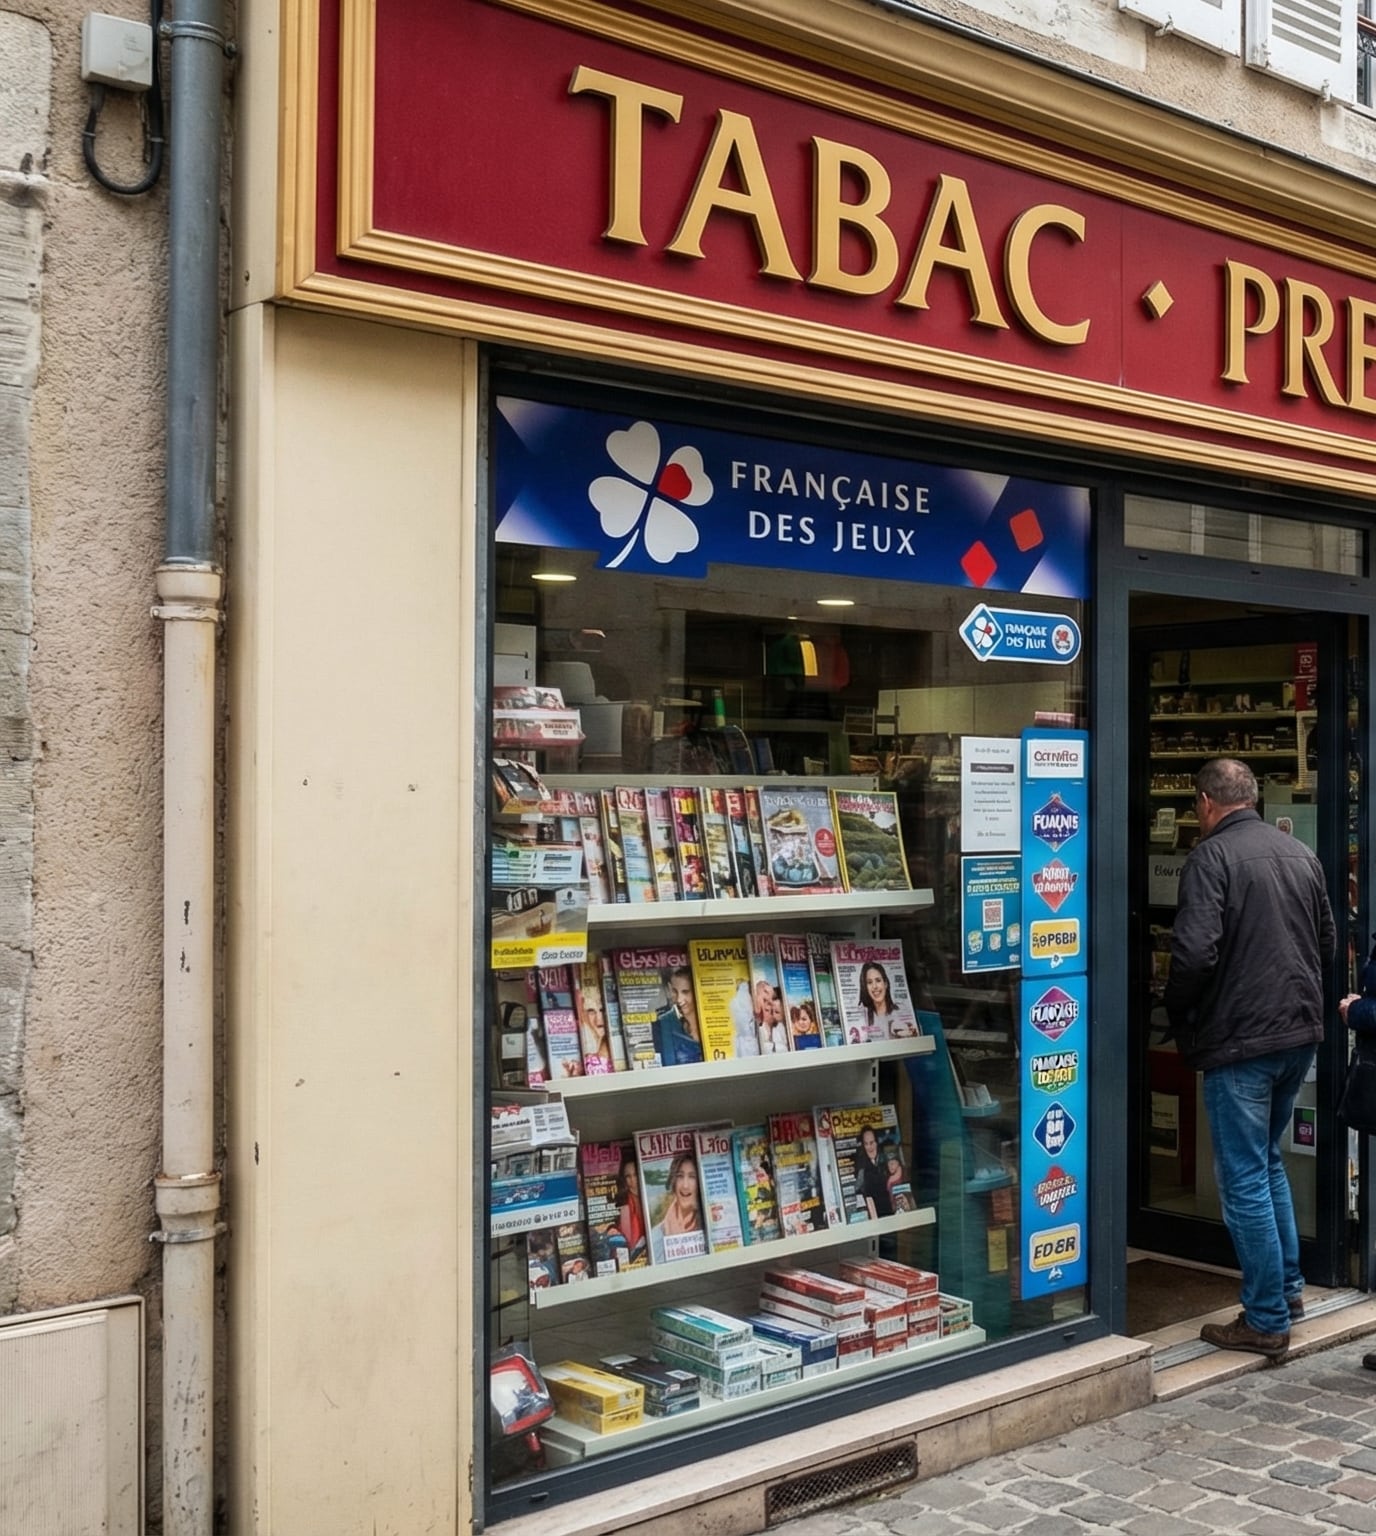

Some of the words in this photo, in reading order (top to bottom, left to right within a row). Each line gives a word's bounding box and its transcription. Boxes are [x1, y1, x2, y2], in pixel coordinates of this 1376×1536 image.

[567, 65, 1091, 346] TABAC
[731, 461, 931, 514] FRANÇAISE
[748, 511, 816, 545] DES
[833, 520, 916, 556] JEUX
